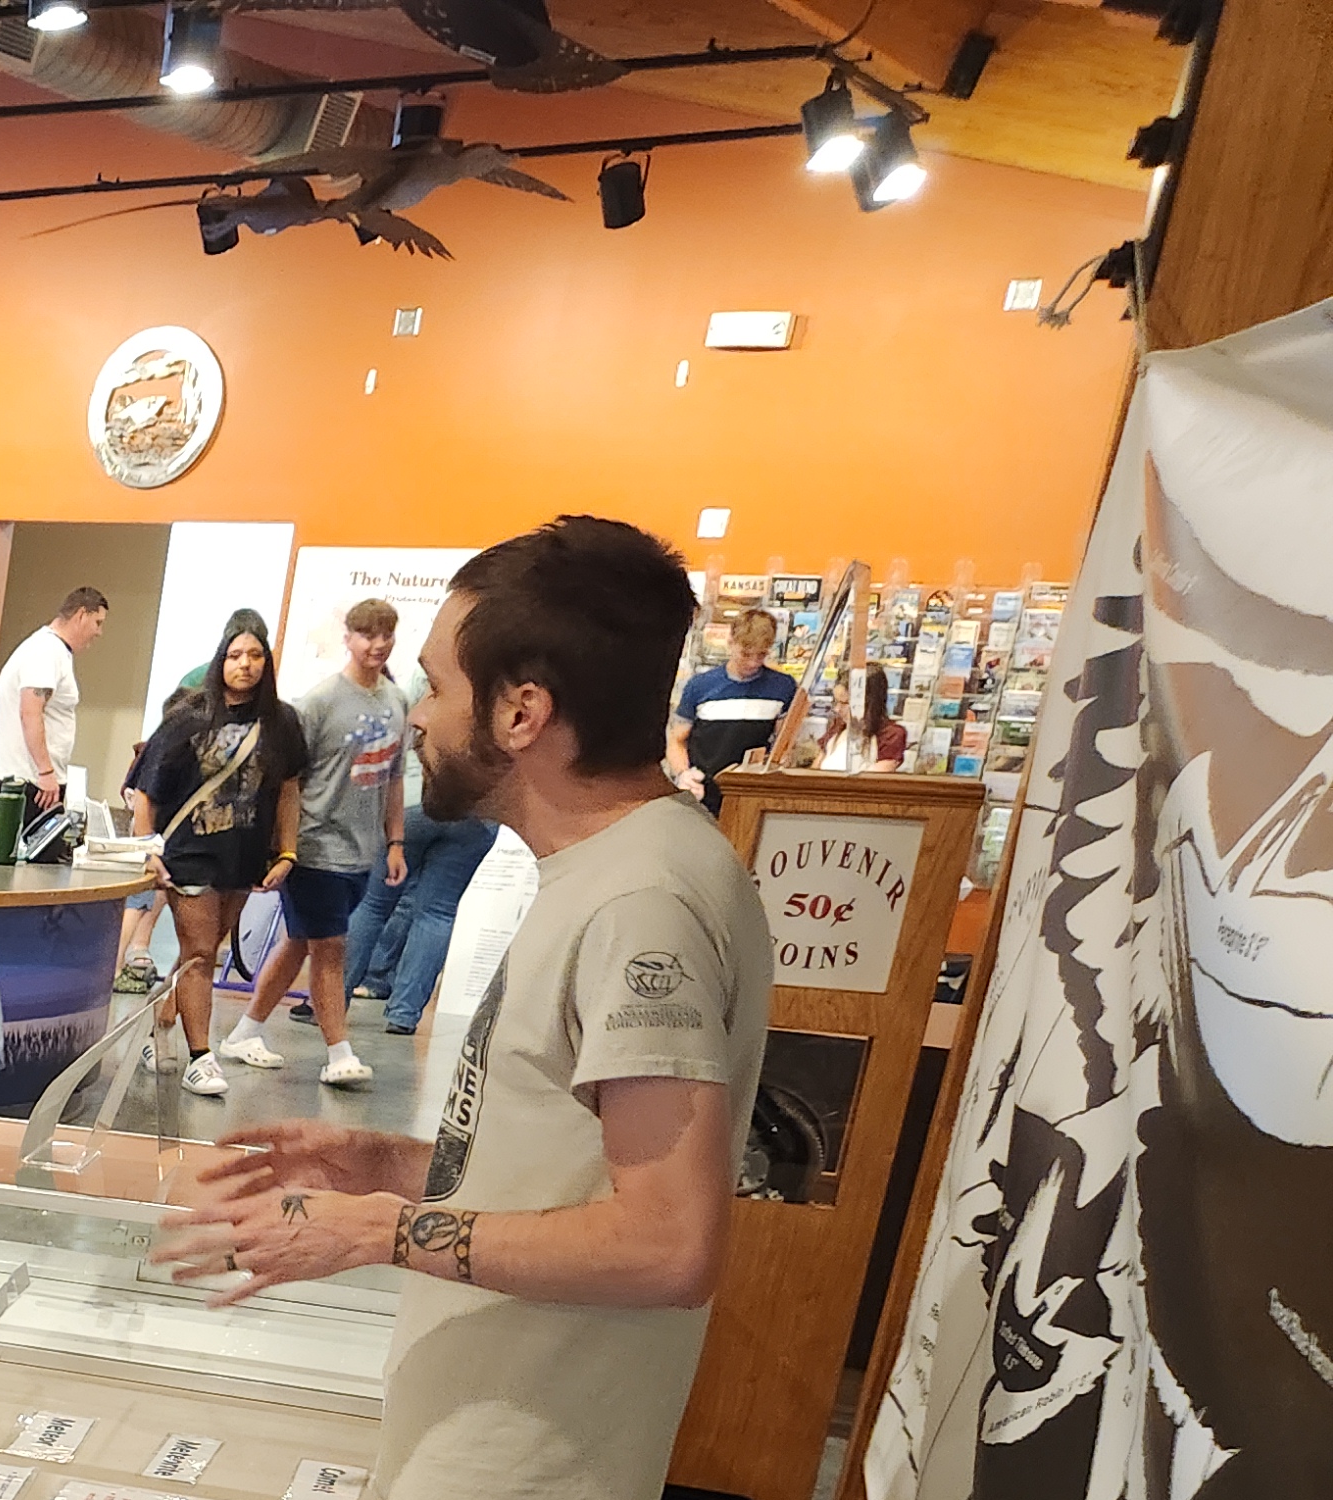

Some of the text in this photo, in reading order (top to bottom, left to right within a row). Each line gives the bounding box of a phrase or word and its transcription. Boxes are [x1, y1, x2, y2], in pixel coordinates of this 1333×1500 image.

[349, 571, 381, 586] The
[723, 580, 765, 591] KANSAS
[783, 893, 856, 927] 50¢
[770, 935, 859, 970] OINS
[36, 1417, 75, 1447] Meteor
[154, 1439, 202, 1477] Meteorite
[312, 1467, 346, 1494] Comet
